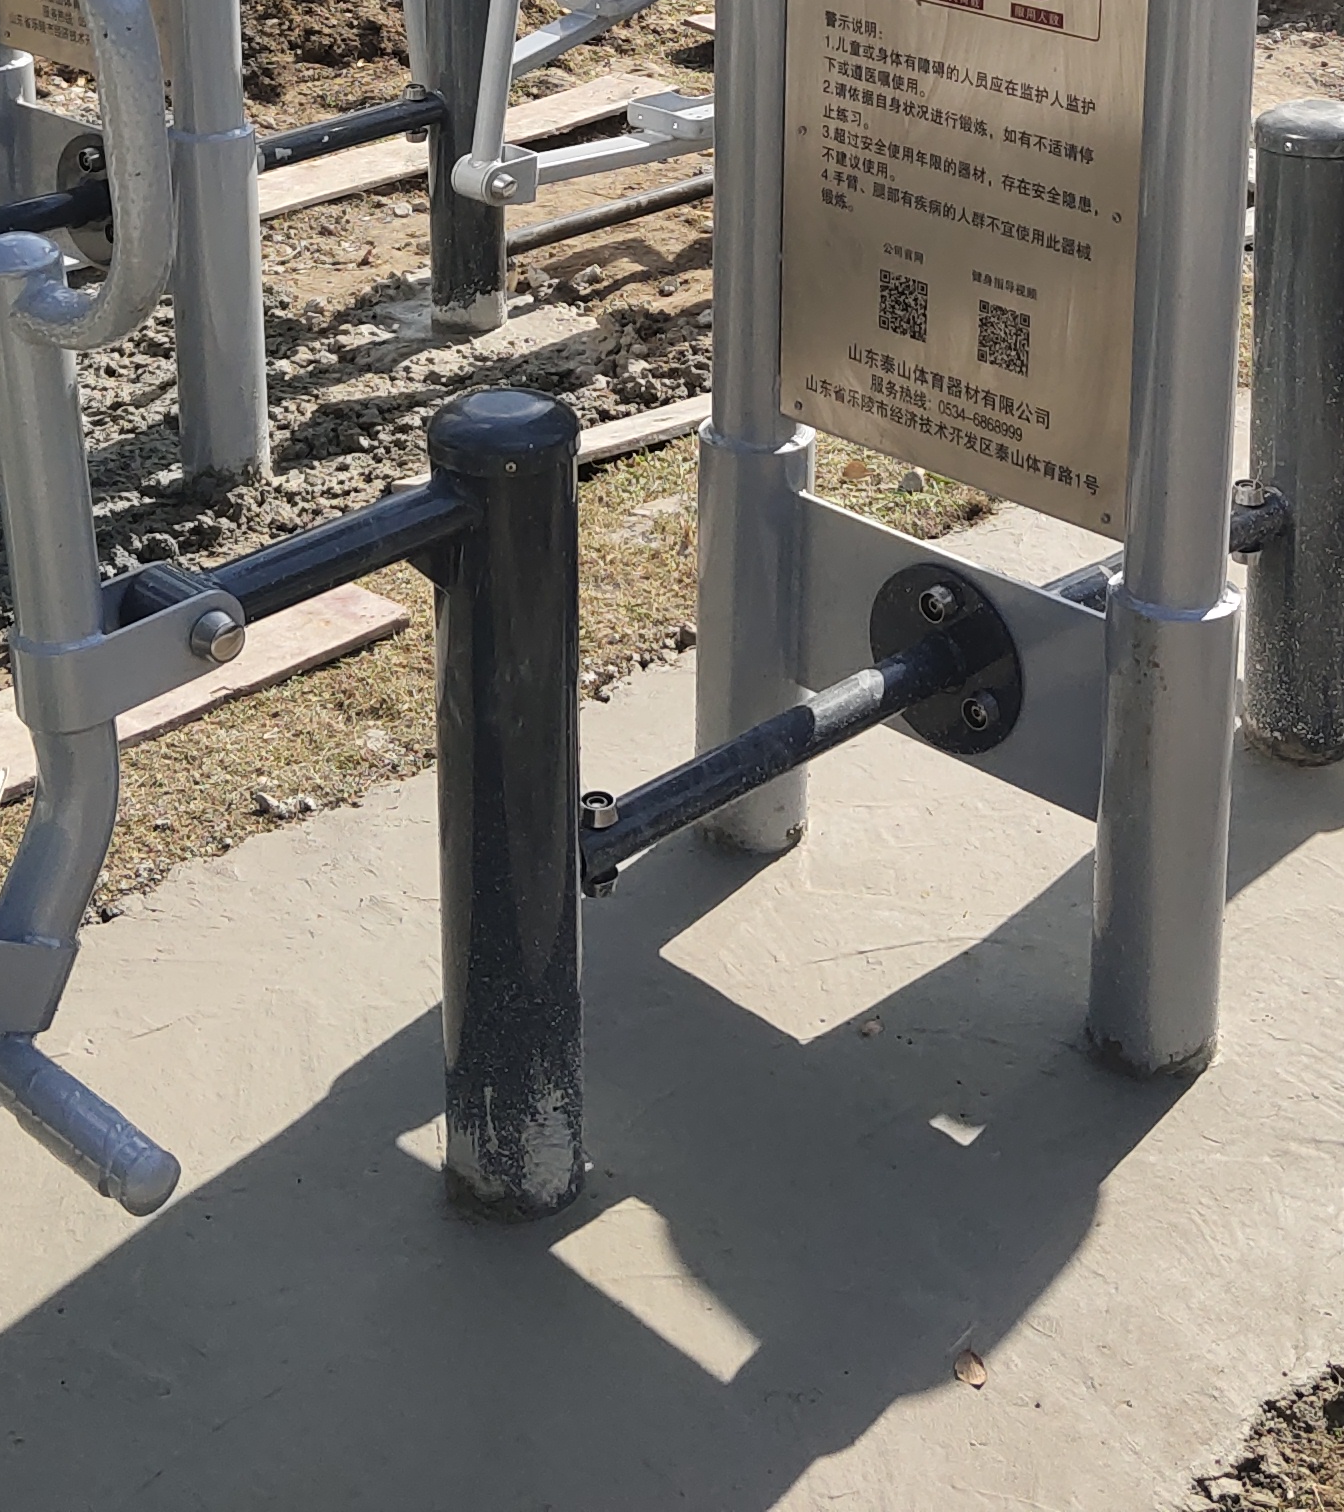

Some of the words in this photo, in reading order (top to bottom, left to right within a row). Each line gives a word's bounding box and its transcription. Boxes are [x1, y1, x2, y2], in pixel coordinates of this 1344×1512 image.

[825, 10, 882, 39] 警示说明：
[823, 103, 869, 130] 止练习。
[821, 145, 895, 182] 不建议使用。
[848, 343, 1050, 430] 山东泰山体育器材有限公司
[806, 374, 1099, 496] 山东省乐陵市经济技术开发区泰山体育路1号
